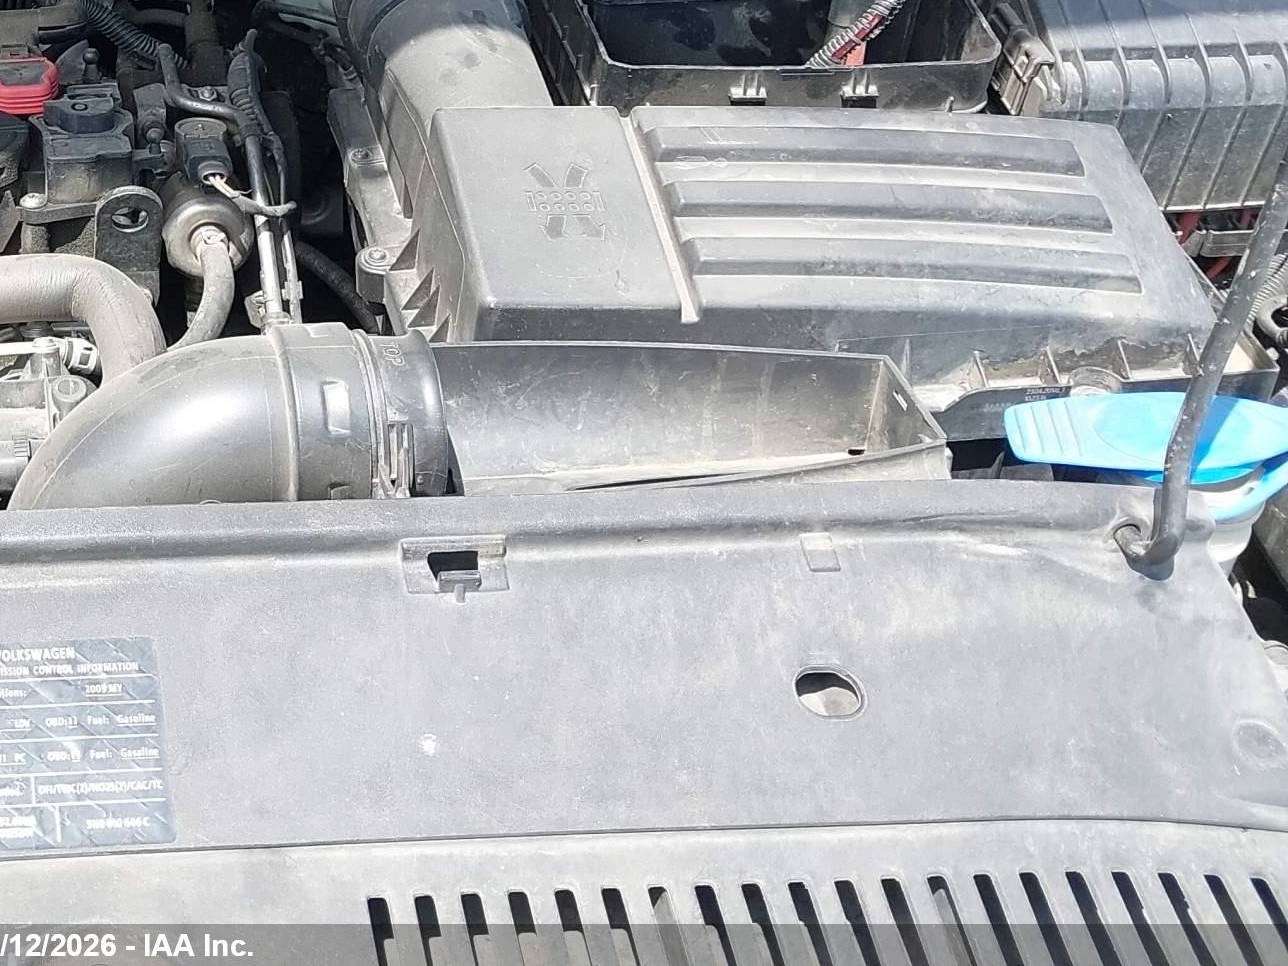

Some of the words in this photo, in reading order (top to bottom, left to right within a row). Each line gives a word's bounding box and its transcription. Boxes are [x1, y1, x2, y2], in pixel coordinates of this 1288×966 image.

[379, 341, 406, 366] TOP
[33, 663, 74, 676] CONTROL
[77, 661, 139, 674] INFORMATION
[87, 714, 110, 726] Fuel:
[117, 712, 156, 724] Gasoline
[89, 748, 113, 760] Fuel:
[120, 746, 160, 759] Gasoline
